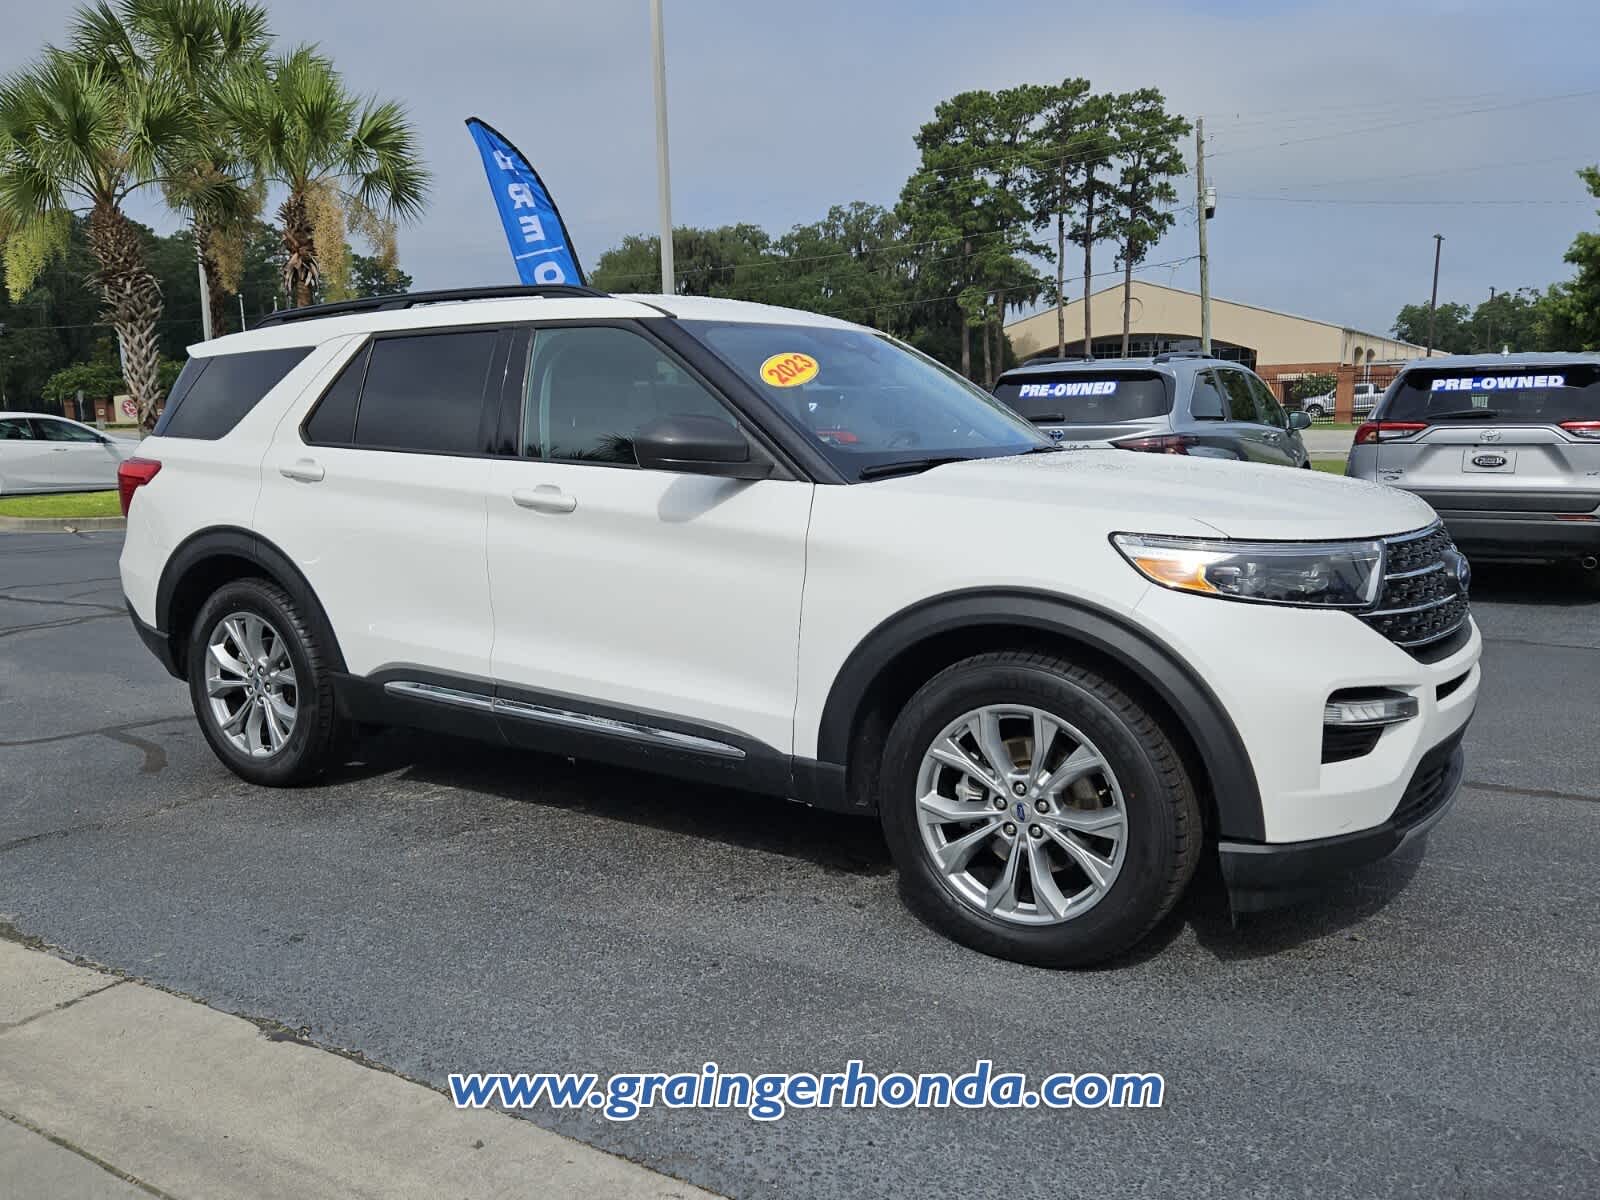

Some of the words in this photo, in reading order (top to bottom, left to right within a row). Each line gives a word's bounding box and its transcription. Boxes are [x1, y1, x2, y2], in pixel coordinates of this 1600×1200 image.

[767, 354, 813, 384] 2023
[1019, 381, 1117, 397] PRE-OWNED
[1431, 375, 1564, 391] PRE-OWNED
